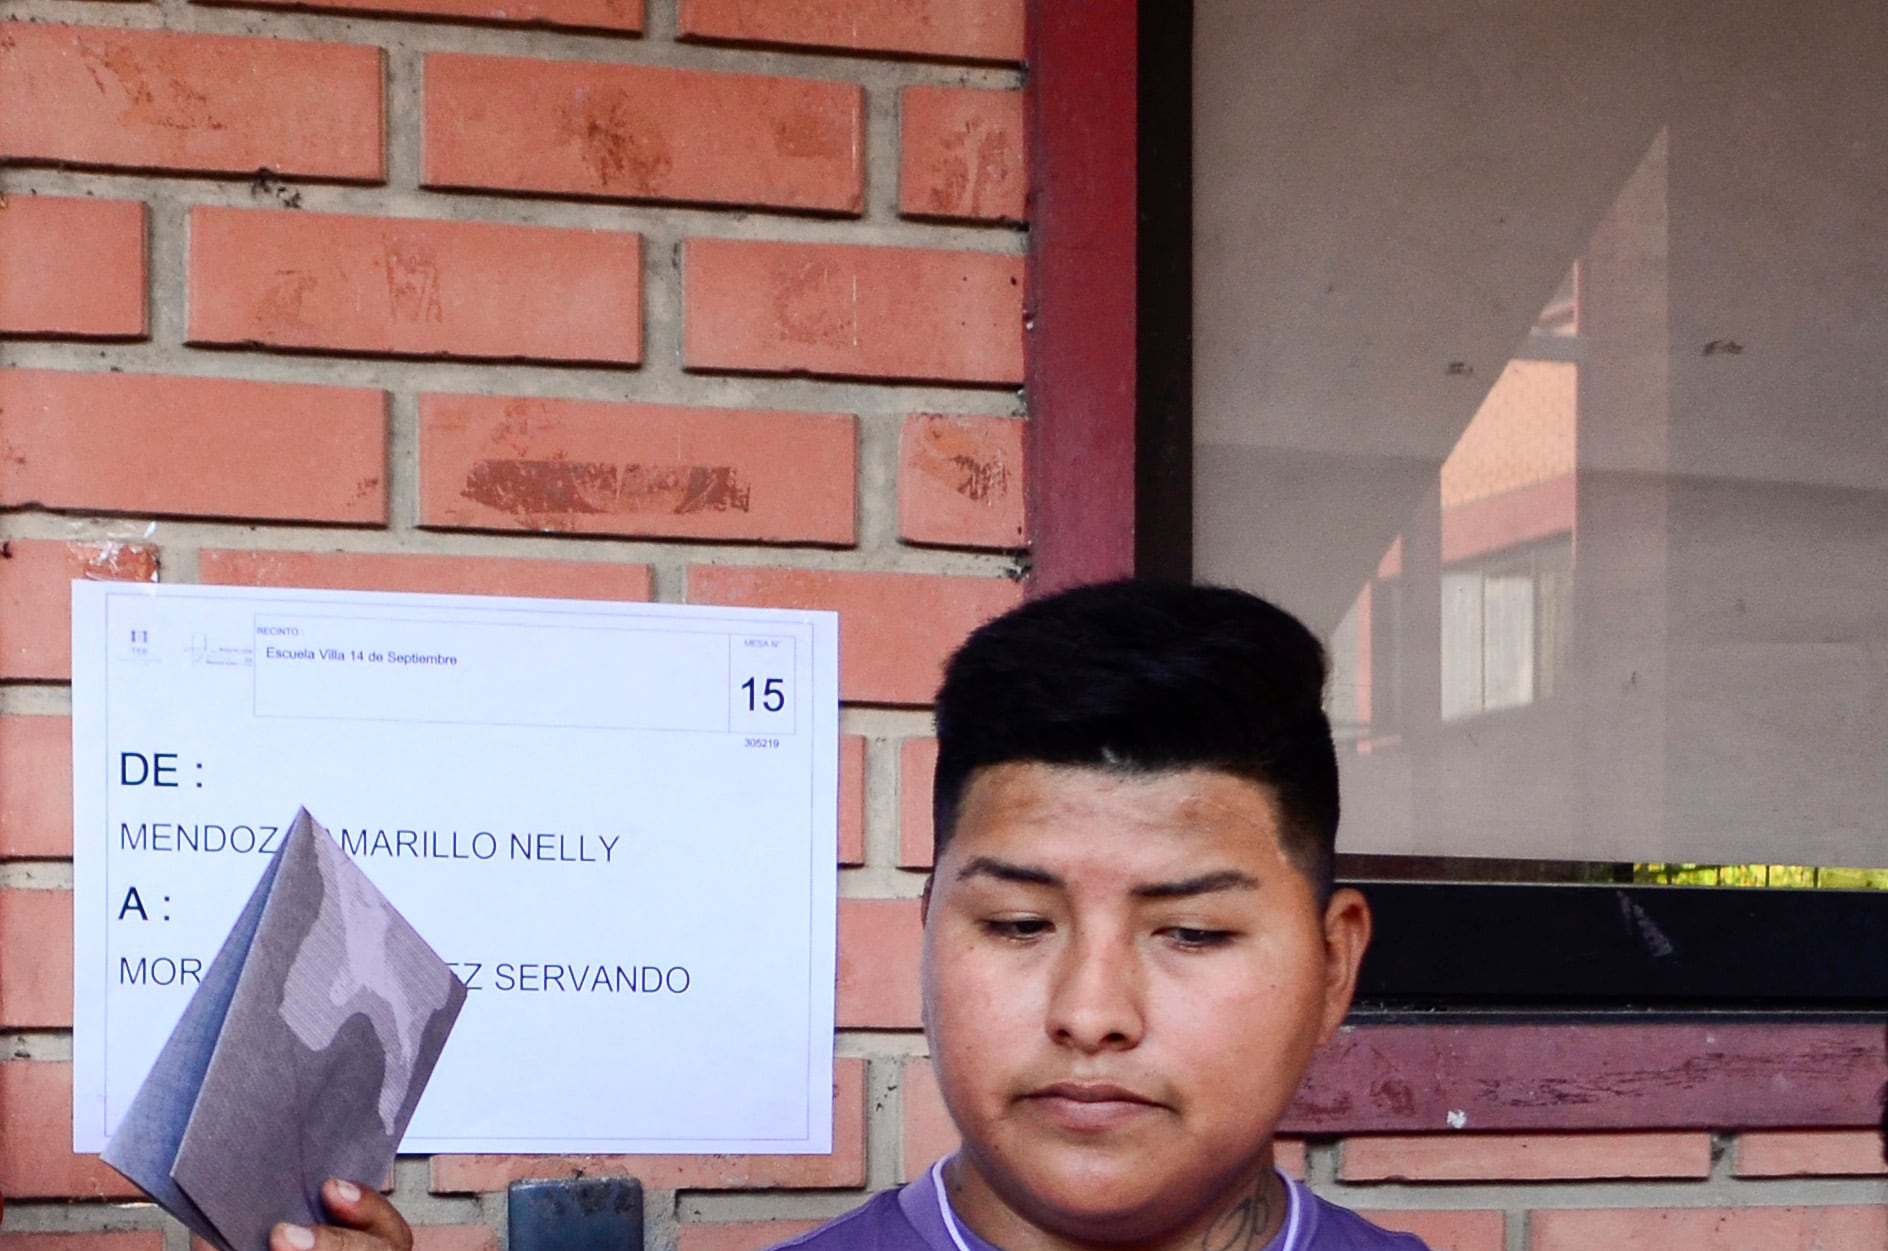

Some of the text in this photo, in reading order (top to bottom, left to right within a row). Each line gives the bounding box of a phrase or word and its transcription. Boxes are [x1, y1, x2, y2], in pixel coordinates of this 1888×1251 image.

[266, 645, 315, 661] Escuela
[319, 647, 345, 662] Villa
[350, 649, 364, 662] 14
[368, 651, 384, 664] de
[387, 650, 458, 667] Septiembre
[744, 639, 769, 648] MESA
[741, 676, 785, 713] 15
[120, 822, 620, 862] MENDOZ MARILLO NELLY
[120, 957, 203, 986] MOR
[495, 963, 691, 994] SERVANDO
